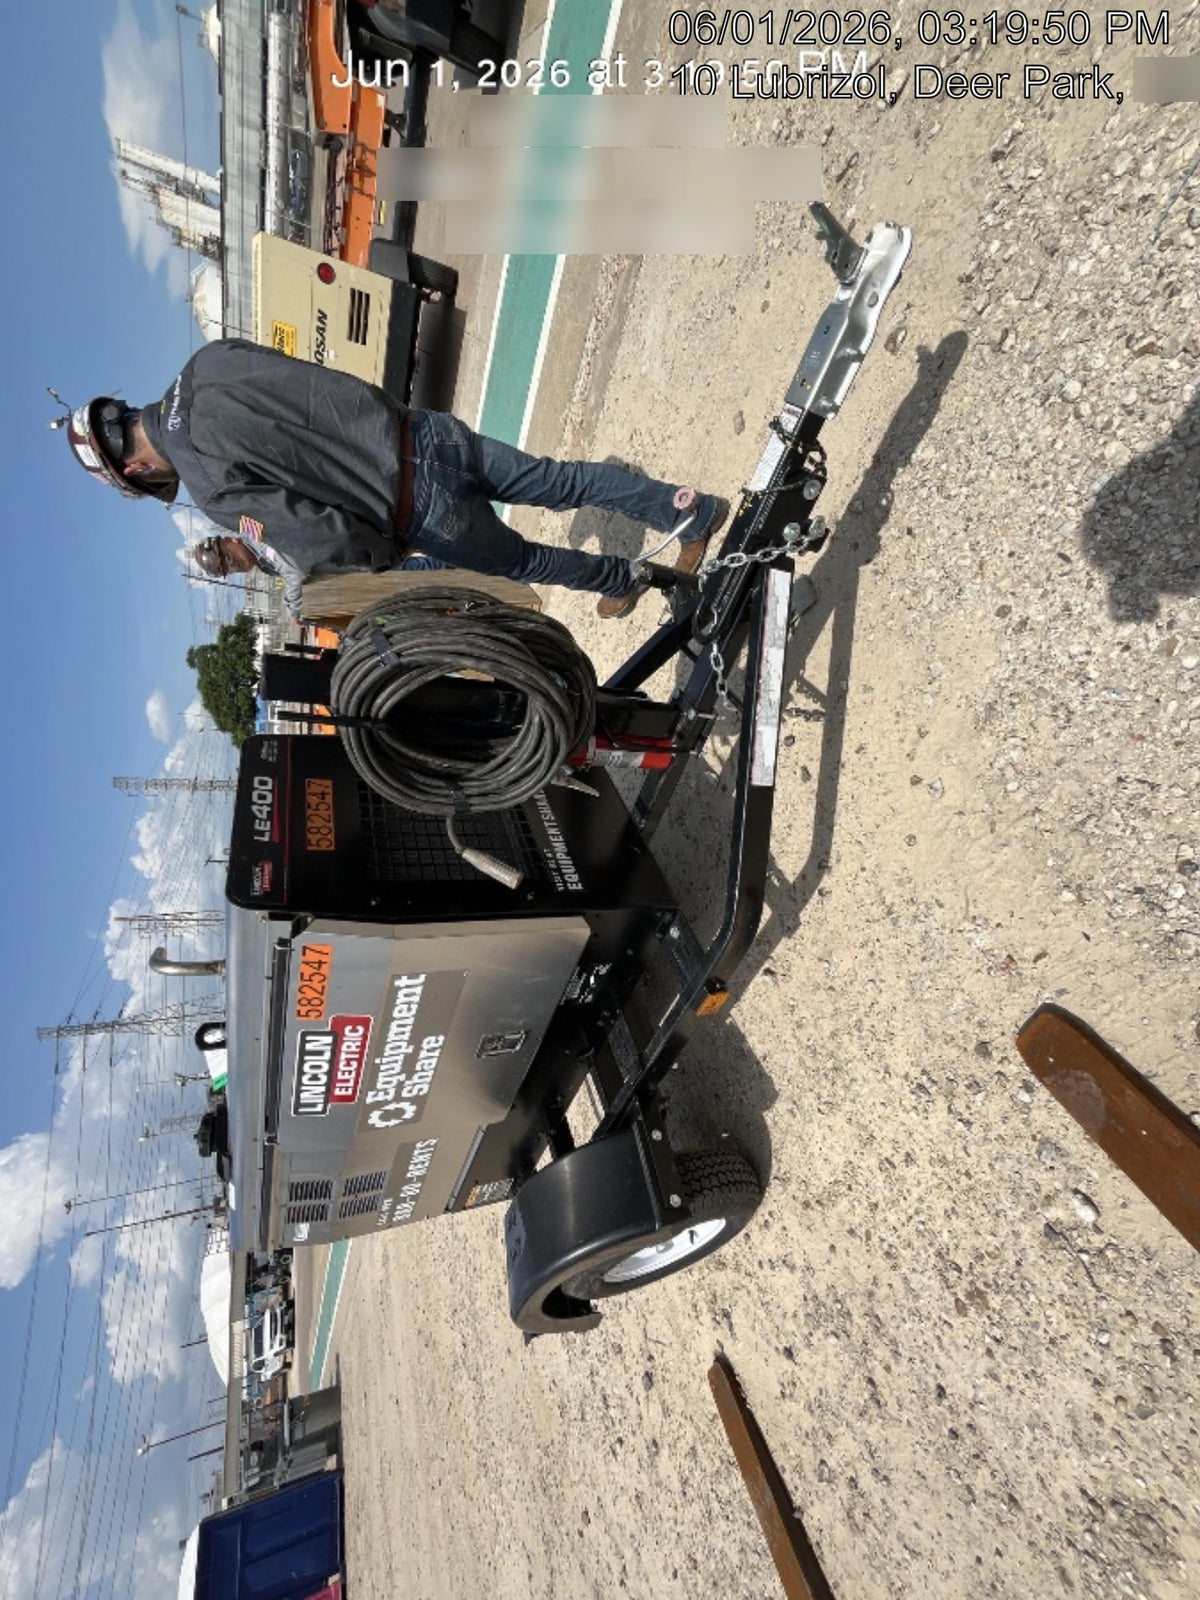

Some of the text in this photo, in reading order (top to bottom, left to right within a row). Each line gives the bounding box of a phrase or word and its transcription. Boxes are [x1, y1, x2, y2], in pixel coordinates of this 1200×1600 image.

[251, 776, 273, 842] LE400
[307, 779, 332, 849] 582547
[296, 945, 330, 1020] 582547
[298, 1035, 334, 1112] LINCOLN
[334, 1025, 364, 1096] ELECTRIC
[365, 973, 427, 1104] Equipment
[400, 1034, 445, 1098] Share
